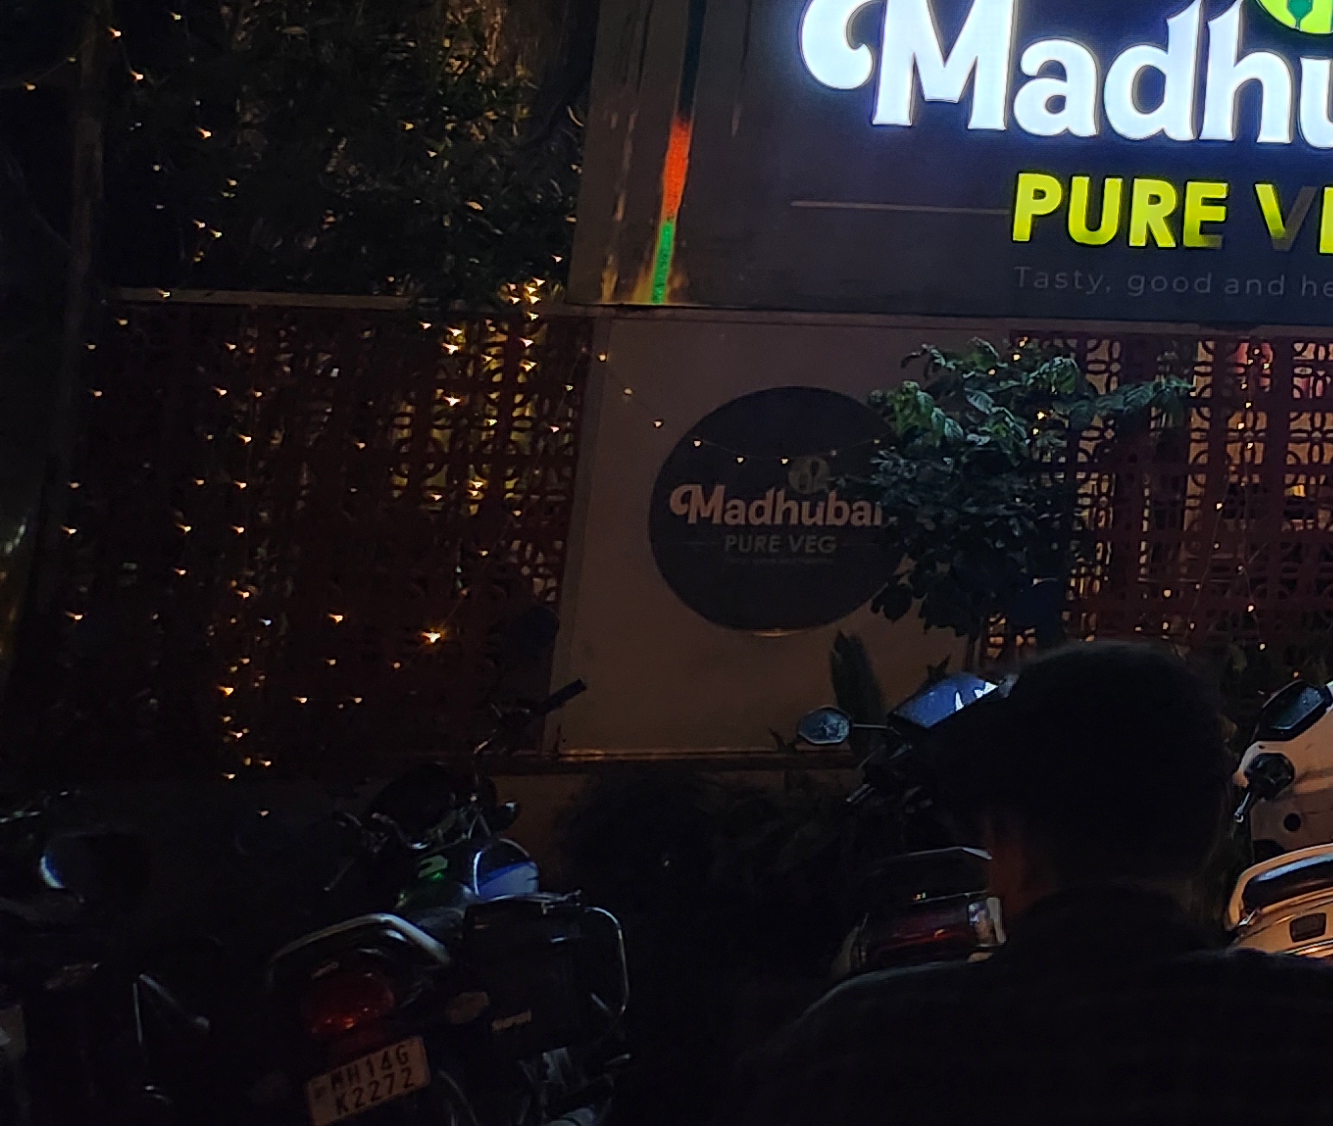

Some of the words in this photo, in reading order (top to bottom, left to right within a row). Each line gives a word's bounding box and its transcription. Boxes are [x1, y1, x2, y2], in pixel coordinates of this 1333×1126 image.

[1011, 171, 1229, 249] PURE
[1013, 266, 1111, 295] Tasty,
[1127, 272, 1212, 298] good
[1225, 275, 1284, 297] and
[725, 534, 782, 554] PURE
[789, 535, 837, 554] VEG
[336, 1067, 414, 1115] K2272
